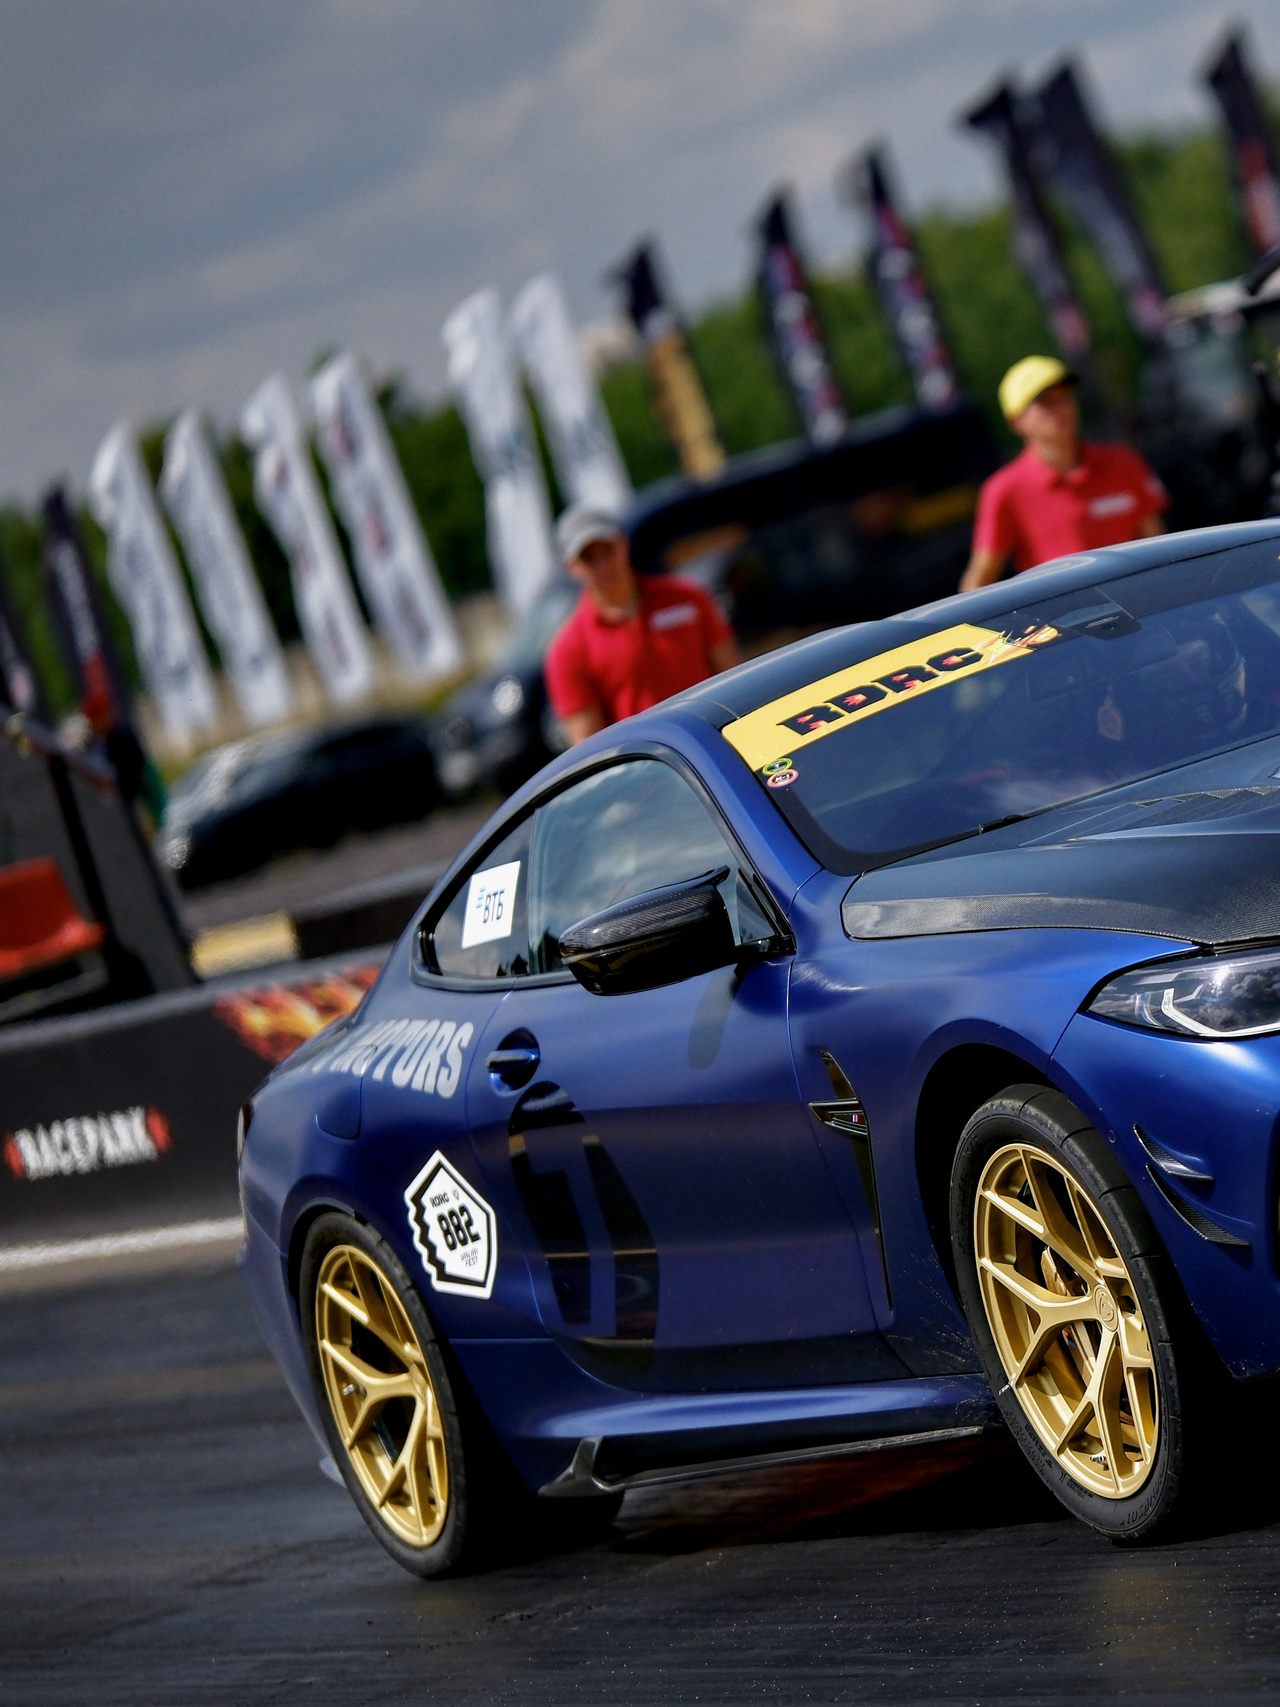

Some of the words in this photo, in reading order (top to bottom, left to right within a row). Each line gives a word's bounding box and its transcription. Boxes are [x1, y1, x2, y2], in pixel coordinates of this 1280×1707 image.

[775, 646, 984, 737] RDRC
[14, 1105, 158, 1182] RACEPARK
[437, 1203, 481, 1251] 882
